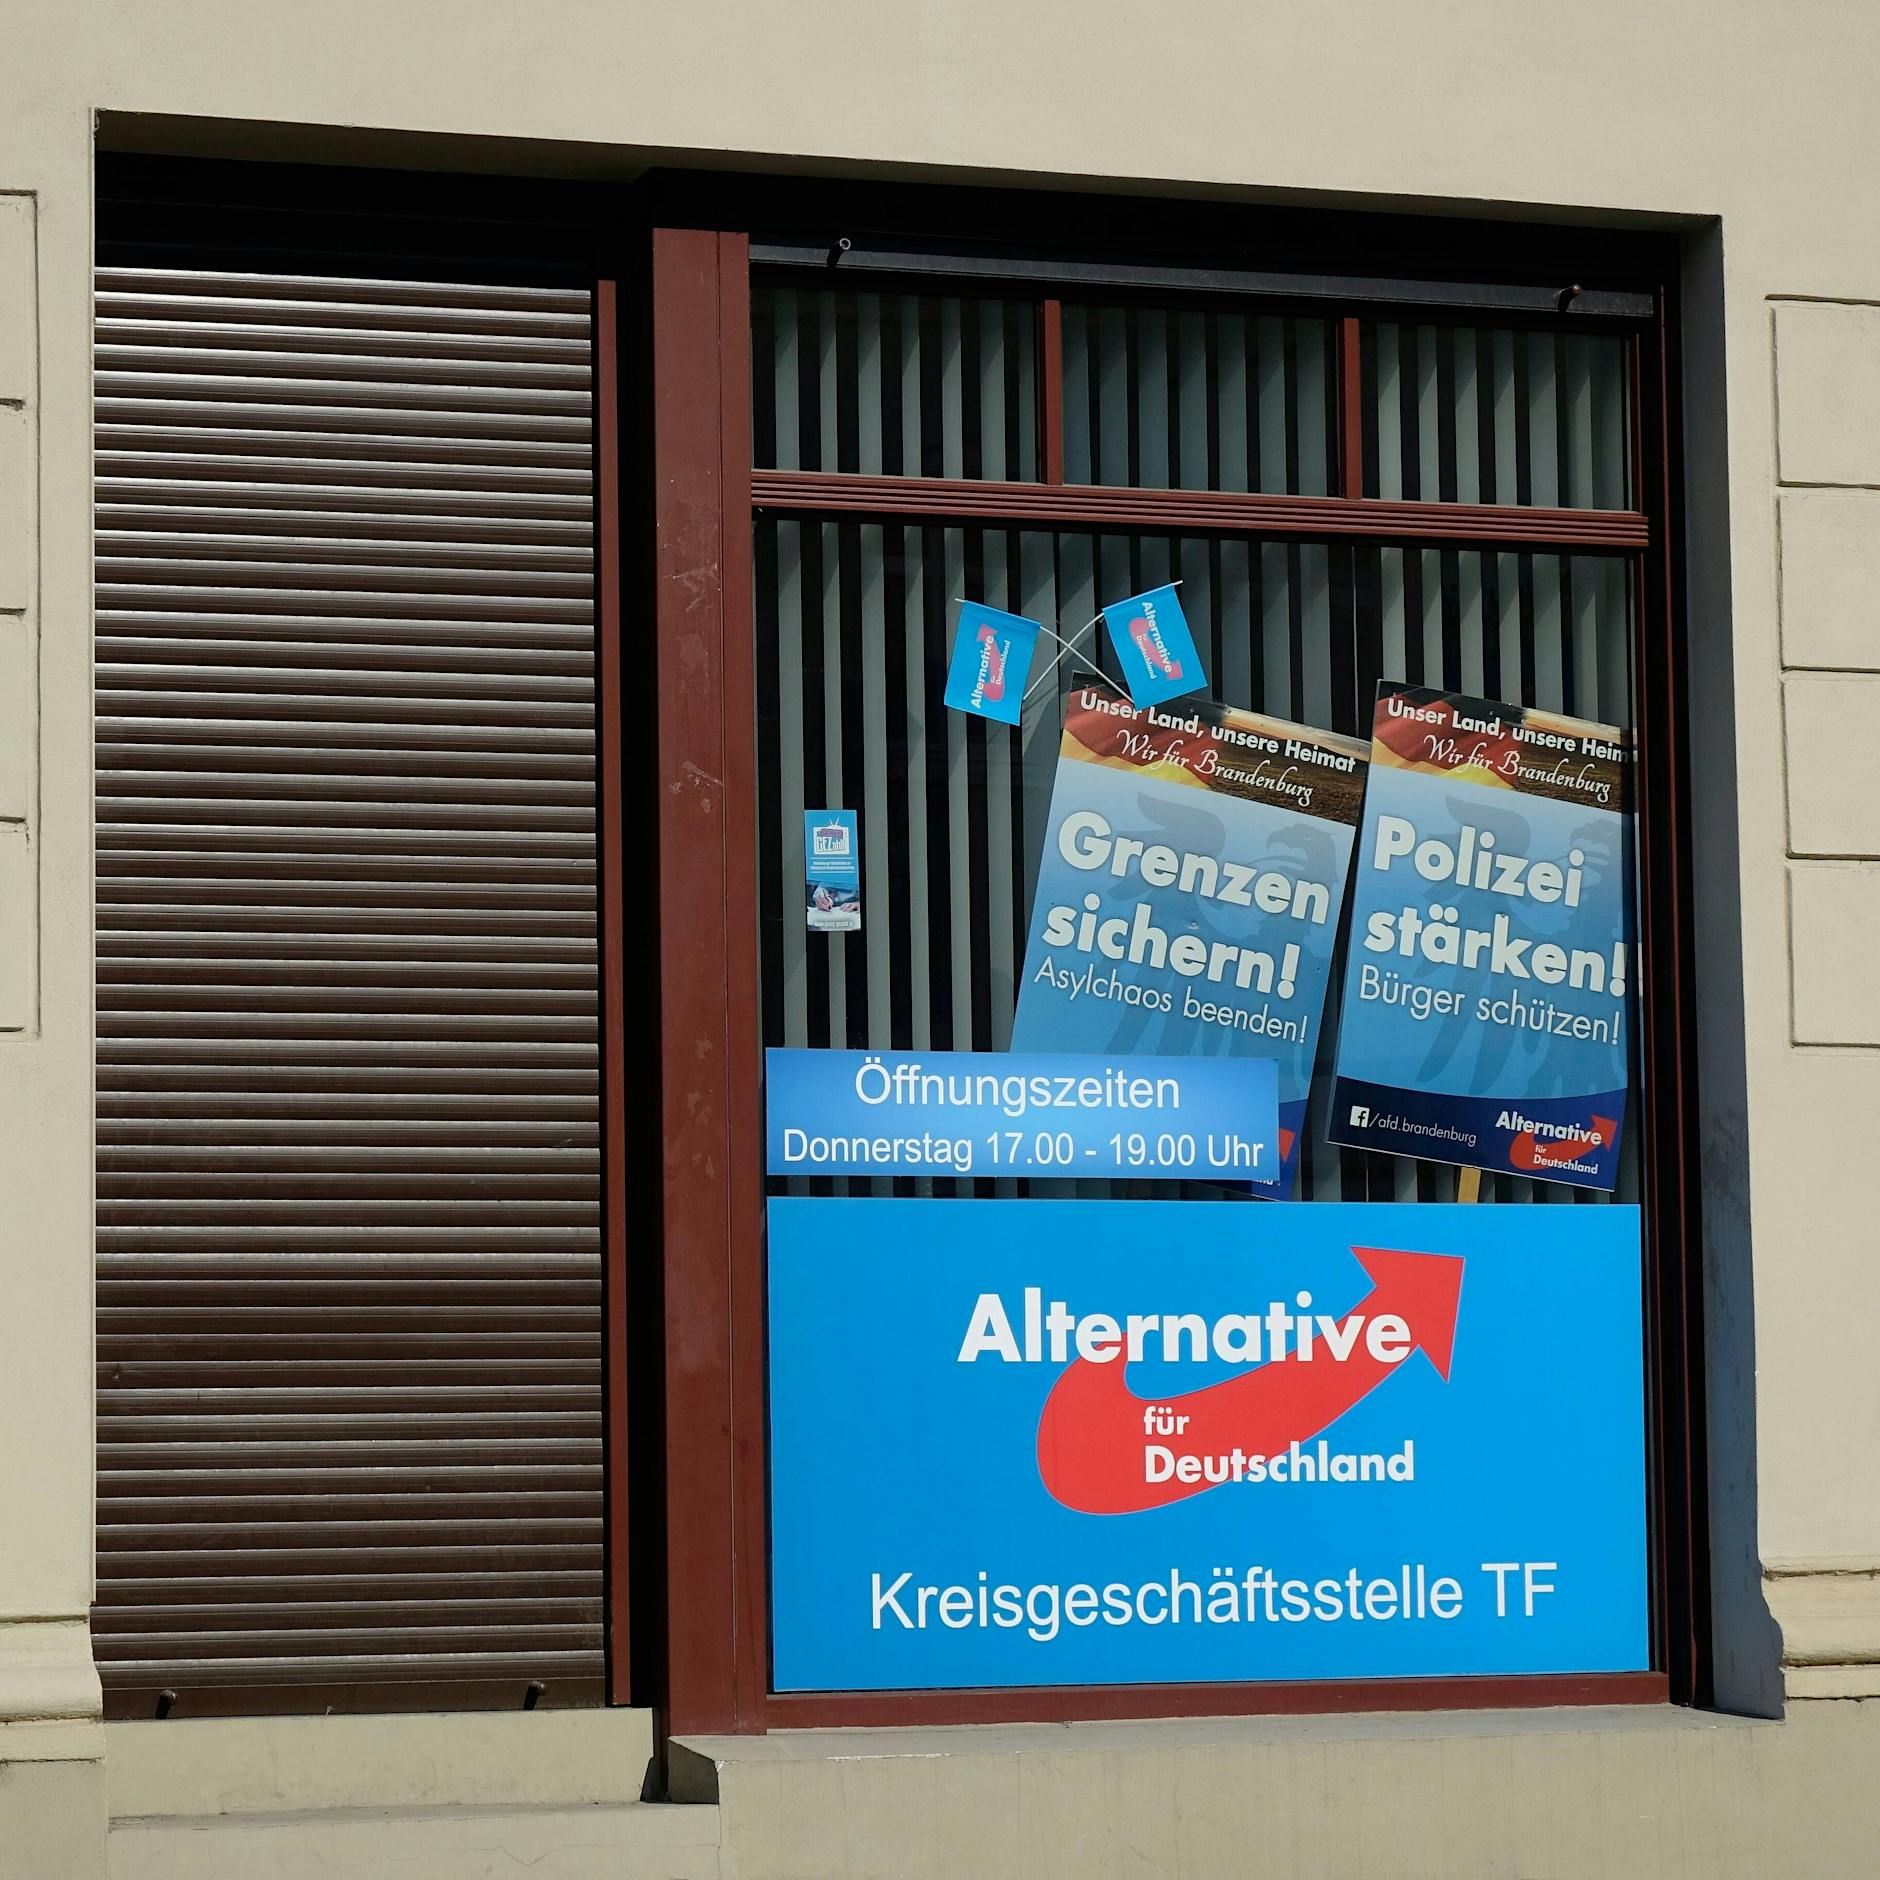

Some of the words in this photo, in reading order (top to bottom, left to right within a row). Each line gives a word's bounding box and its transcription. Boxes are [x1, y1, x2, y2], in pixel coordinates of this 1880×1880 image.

[971, 635, 994, 709] Alternative
[1142, 602, 1172, 673] Alternative
[1080, 690, 1142, 720] Unser
[1148, 706, 1203, 738] Land,
[1211, 725, 1279, 754] unsere
[1285, 738, 1356, 773] Heimat
[1387, 698, 1447, 726] Unser
[1451, 710, 1506, 740] Land,
[1512, 727, 1576, 752] unsere
[1116, 729, 1158, 761] Wir
[1150, 740, 1189, 770] für
[1194, 749, 1314, 807] Brandenburg
[1423, 735, 1463, 764] Wir
[1457, 742, 1494, 773] für
[1497, 750, 1611, 803] Brandenburg
[1058, 811, 1330, 925] Grenzen
[1373, 815, 1585, 908] Polizei
[1041, 893, 1301, 1000] sichern!
[1363, 903, 1628, 997] stärken!
[1033, 955, 1173, 1013] Asylchaos
[1182, 985, 1308, 1044] beenden!
[1359, 963, 1466, 1021] Bürger
[1475, 988, 1620, 1045] schützen!
[854, 1056, 1181, 1117] Öffnungszeiten
[783, 1128, 974, 1171] Donnerstag
[986, 1131, 1075, 1166] 17.00
[1109, 1133, 1197, 1167] 19.00
[1207, 1134, 1264, 1167] Uhr
[1369, 1113, 1477, 1148] /afd.brandenburg
[1495, 1110, 1602, 1145] Alternative
[1534, 1144, 1548, 1154] für
[1533, 1154, 1599, 1175] Deutschland
[957, 1286, 1412, 1364] Alternative
[1143, 1406, 1190, 1436] für
[1143, 1440, 1415, 1484] Deutschland
[870, 1564, 1464, 1641] Kreisgeschäftsstelle
[1481, 1562, 1559, 1617] TF
